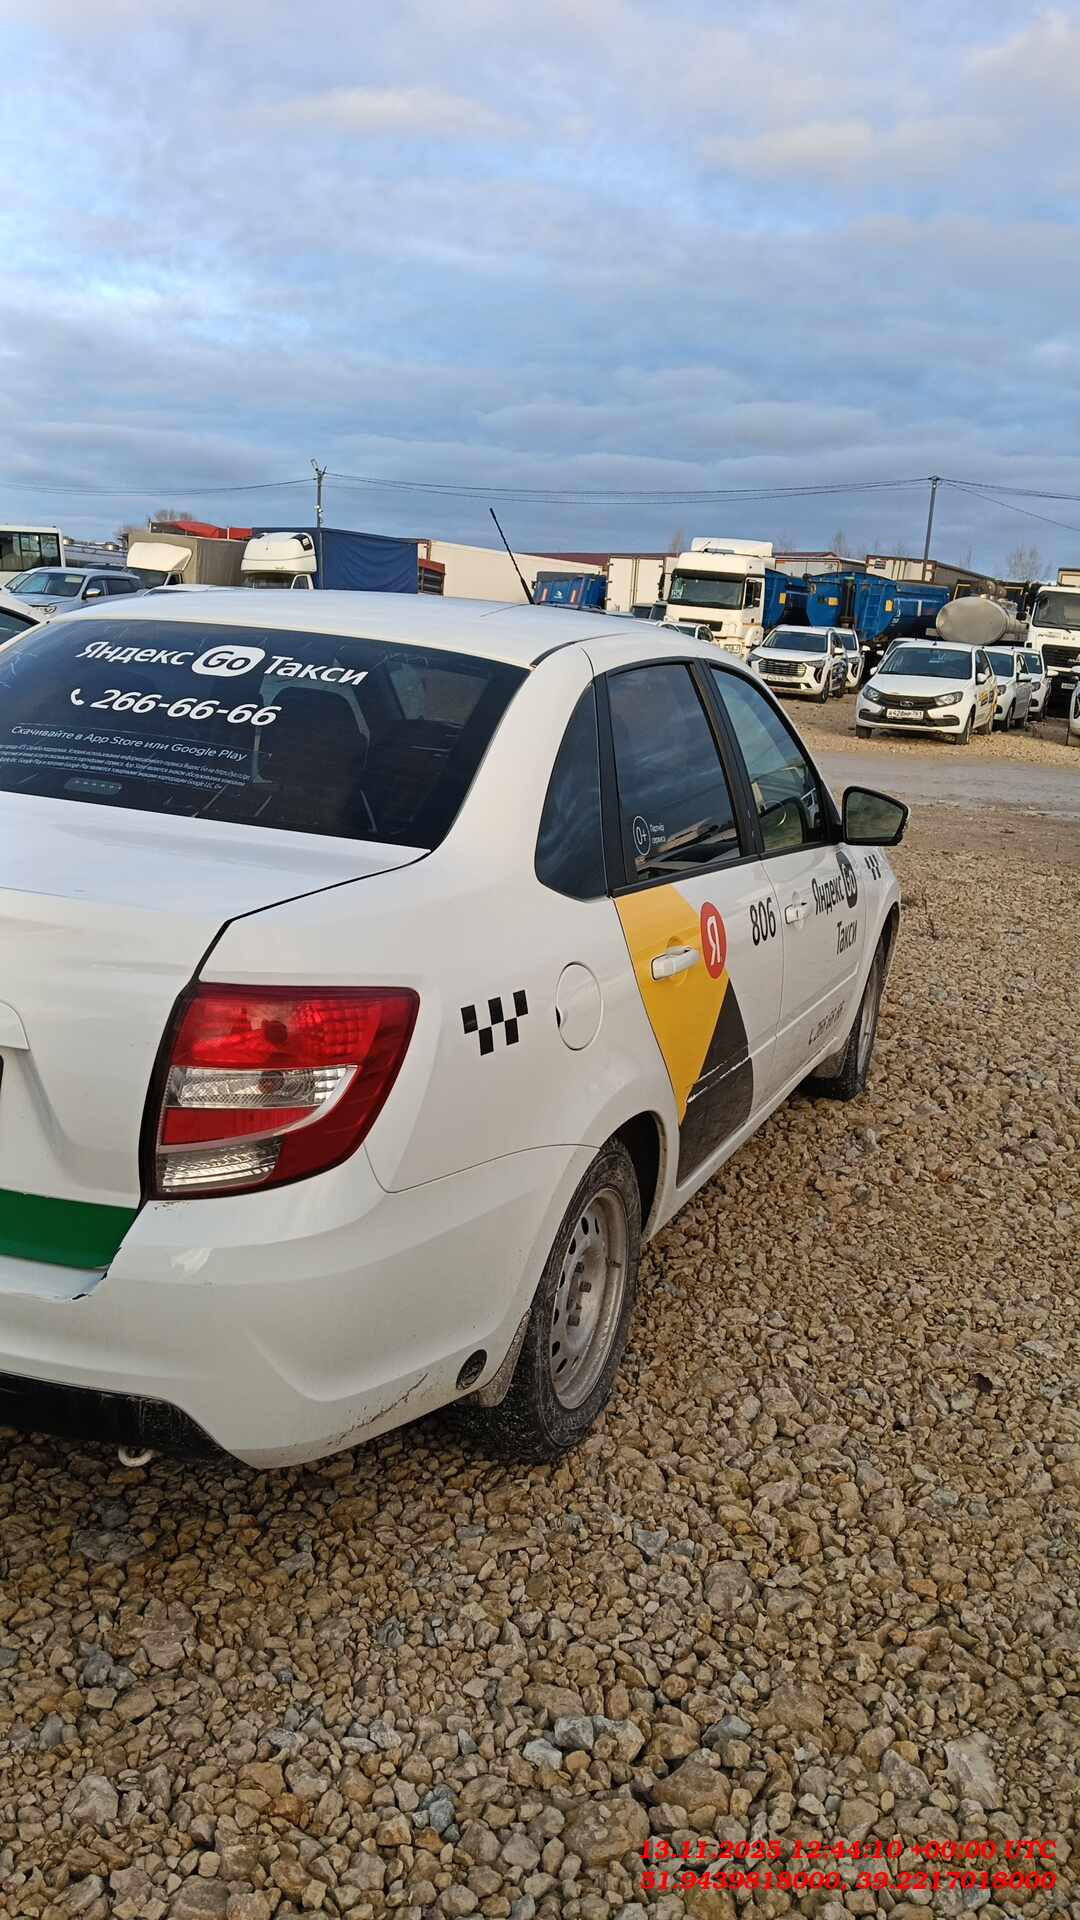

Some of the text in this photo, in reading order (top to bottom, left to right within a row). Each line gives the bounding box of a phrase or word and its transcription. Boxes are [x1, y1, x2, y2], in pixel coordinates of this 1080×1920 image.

[75, 641, 369, 685] Яндекс Go Такси
[90, 689, 282, 726] 266-66-66
[11, 726, 75, 740] Скачивайте
[83, 733, 110, 744] App
[110, 736, 144, 747] Store
[143, 741, 170, 750] или
[171, 743, 217, 757] Google
[218, 749, 248, 762] Play
[811, 877, 845, 916] Яндекс
[706, 915, 722, 966] Я
[750, 897, 776, 946] 806
[836, 920, 858, 956] Такси
